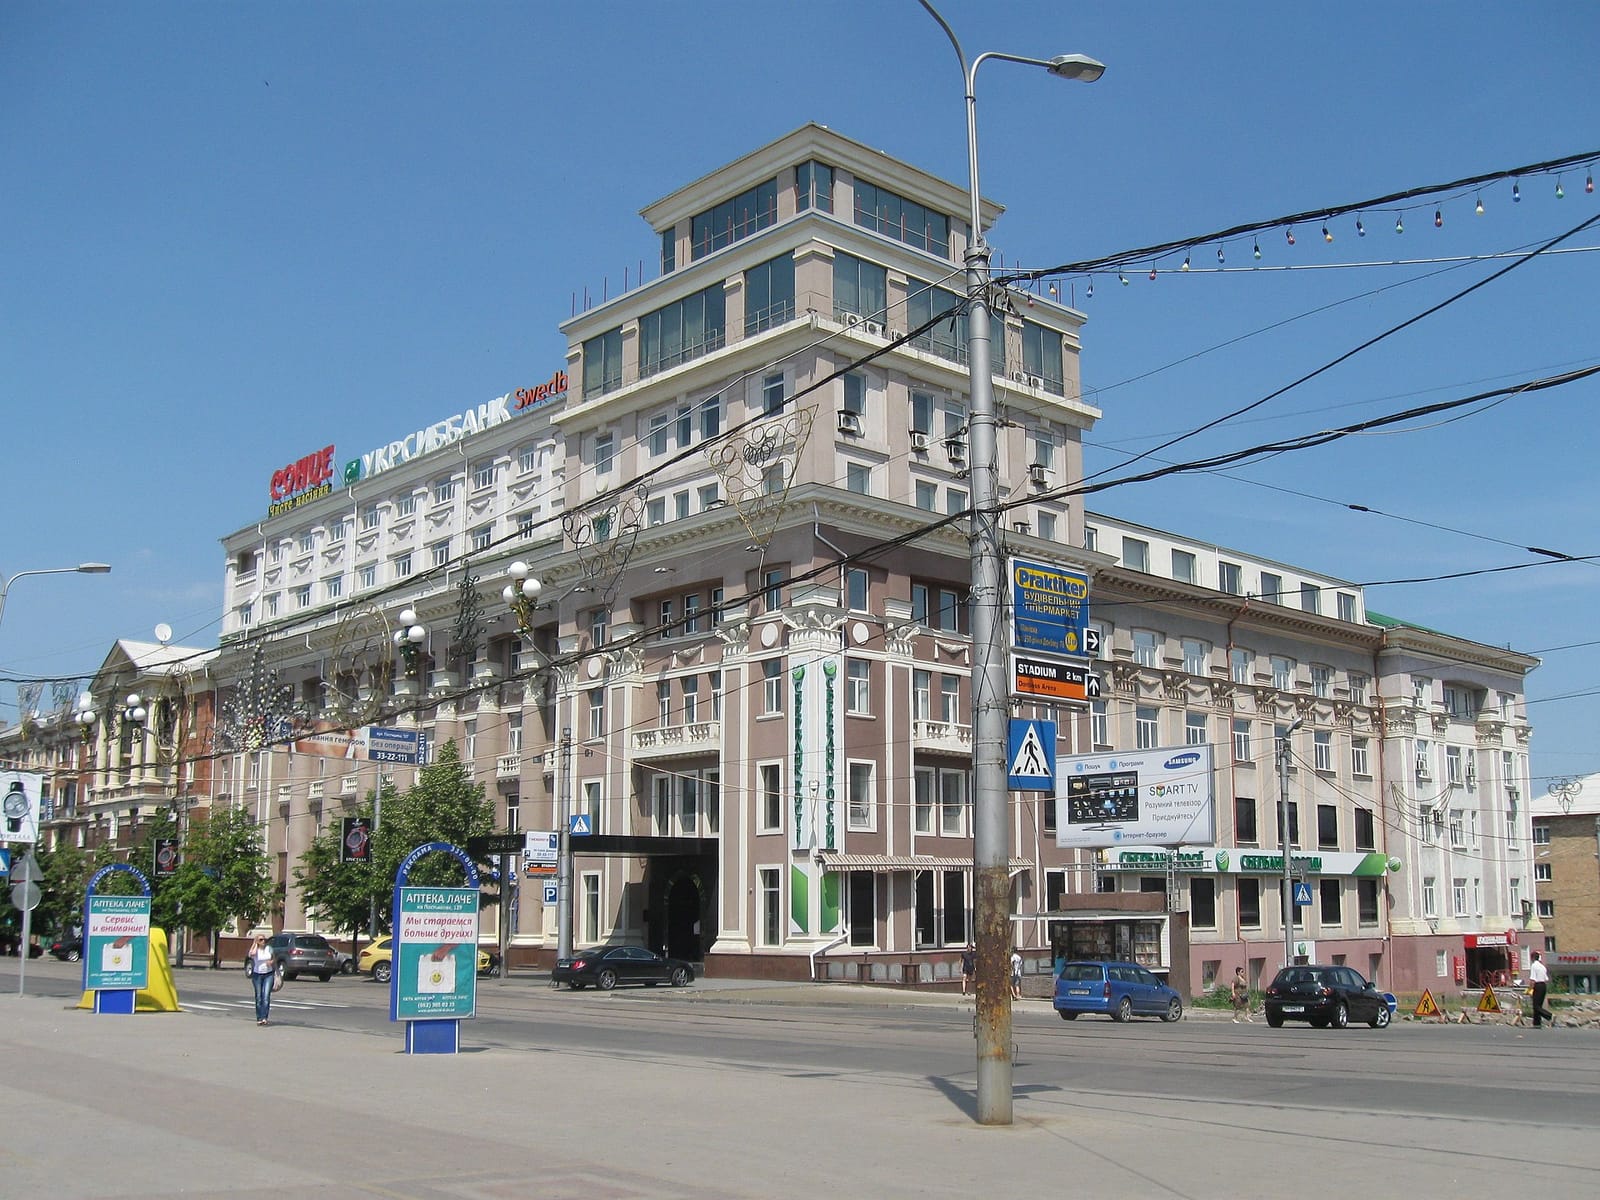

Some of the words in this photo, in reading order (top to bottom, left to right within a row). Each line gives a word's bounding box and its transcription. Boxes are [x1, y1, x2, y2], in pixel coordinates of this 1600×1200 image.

[362, 392, 511, 479] УКРСИББАНК
[1018, 568, 1085, 597] Praktiker
[1023, 590, 1081, 609] БУДІВЕЛЬНИЙ
[1018, 663, 1057, 679] STADIUM
[1066, 671, 1072, 680] 2
[1072, 672, 1082, 682] km
[376, 751, 408, 763] 33-22-111
[1168, 755, 1197, 766] SAMSUNG
[1187, 783, 1199, 795] TV
[402, 845, 433, 875] РЕКЛАМА
[450, 846, 478, 880] 337-00-00
[93, 900, 123, 908] АПТЕКА
[405, 893, 445, 903] АПТЕКА
[105, 916, 135, 926] Сервис
[405, 916, 422, 925] Мы
[423, 917, 473, 927] стараемся
[100, 925, 147, 933] внимание!
[404, 928, 438, 938] больше
[440, 928, 473, 940] других!
